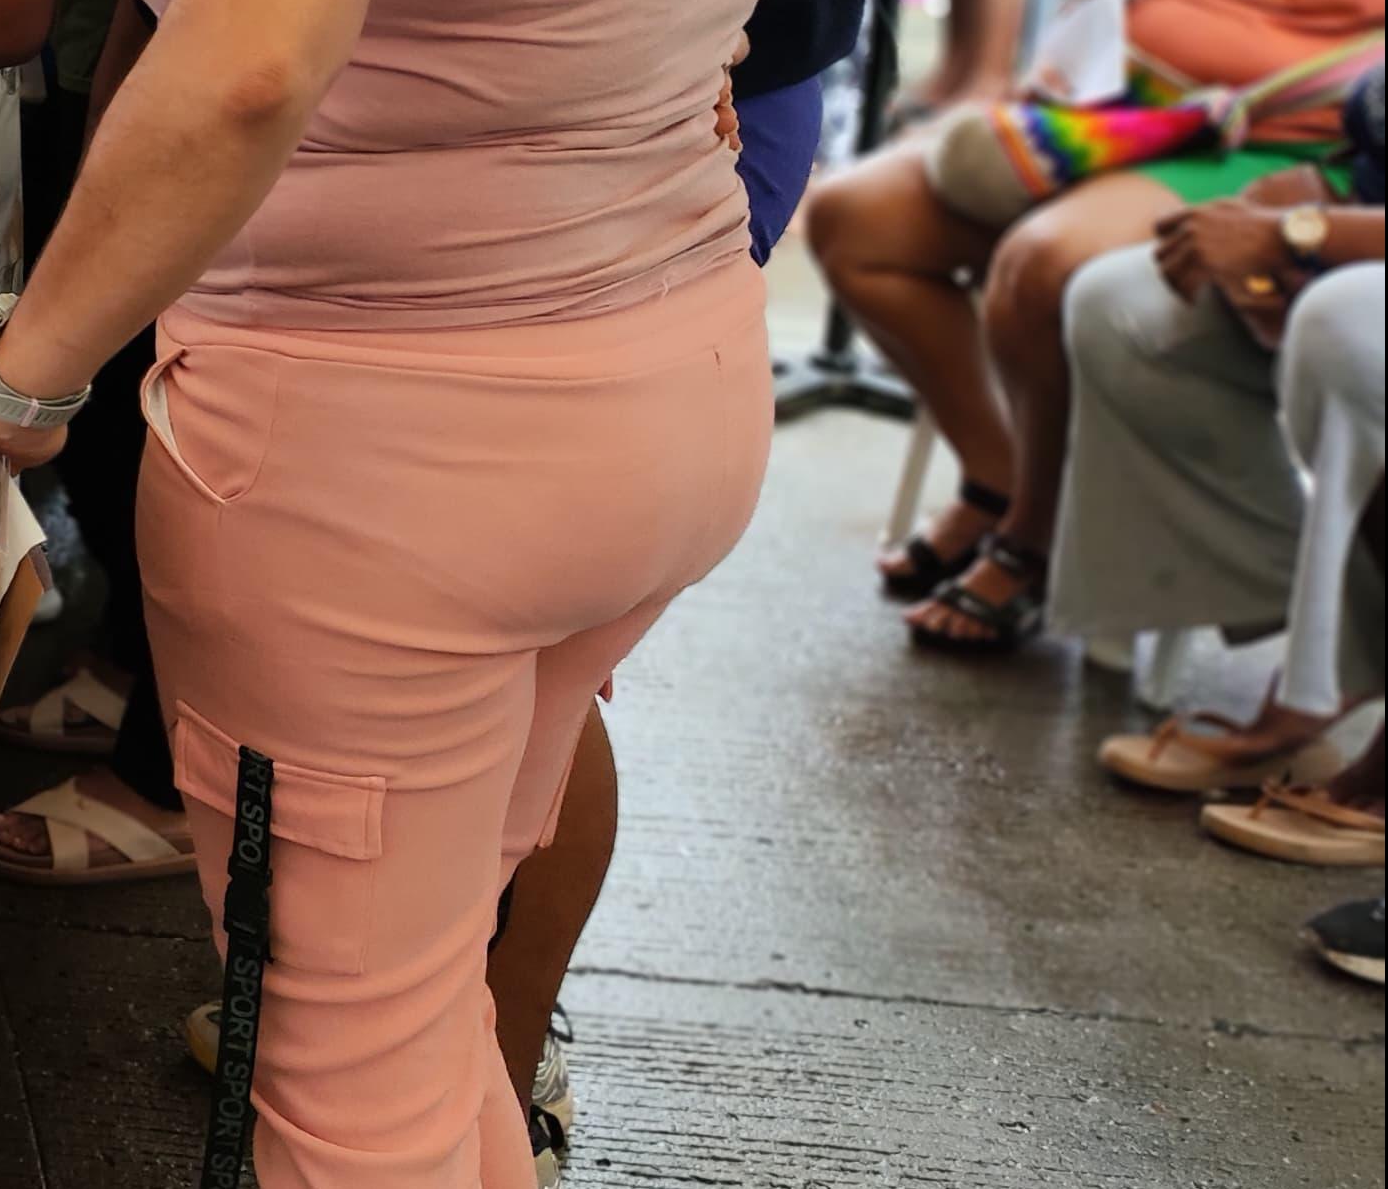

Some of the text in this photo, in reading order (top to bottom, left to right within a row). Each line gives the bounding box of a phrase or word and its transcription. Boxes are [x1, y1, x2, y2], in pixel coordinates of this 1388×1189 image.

[224, 955, 261, 1060] SPORT
[213, 1060, 251, 1155] SPORT
[208, 1152, 238, 1189] SP
